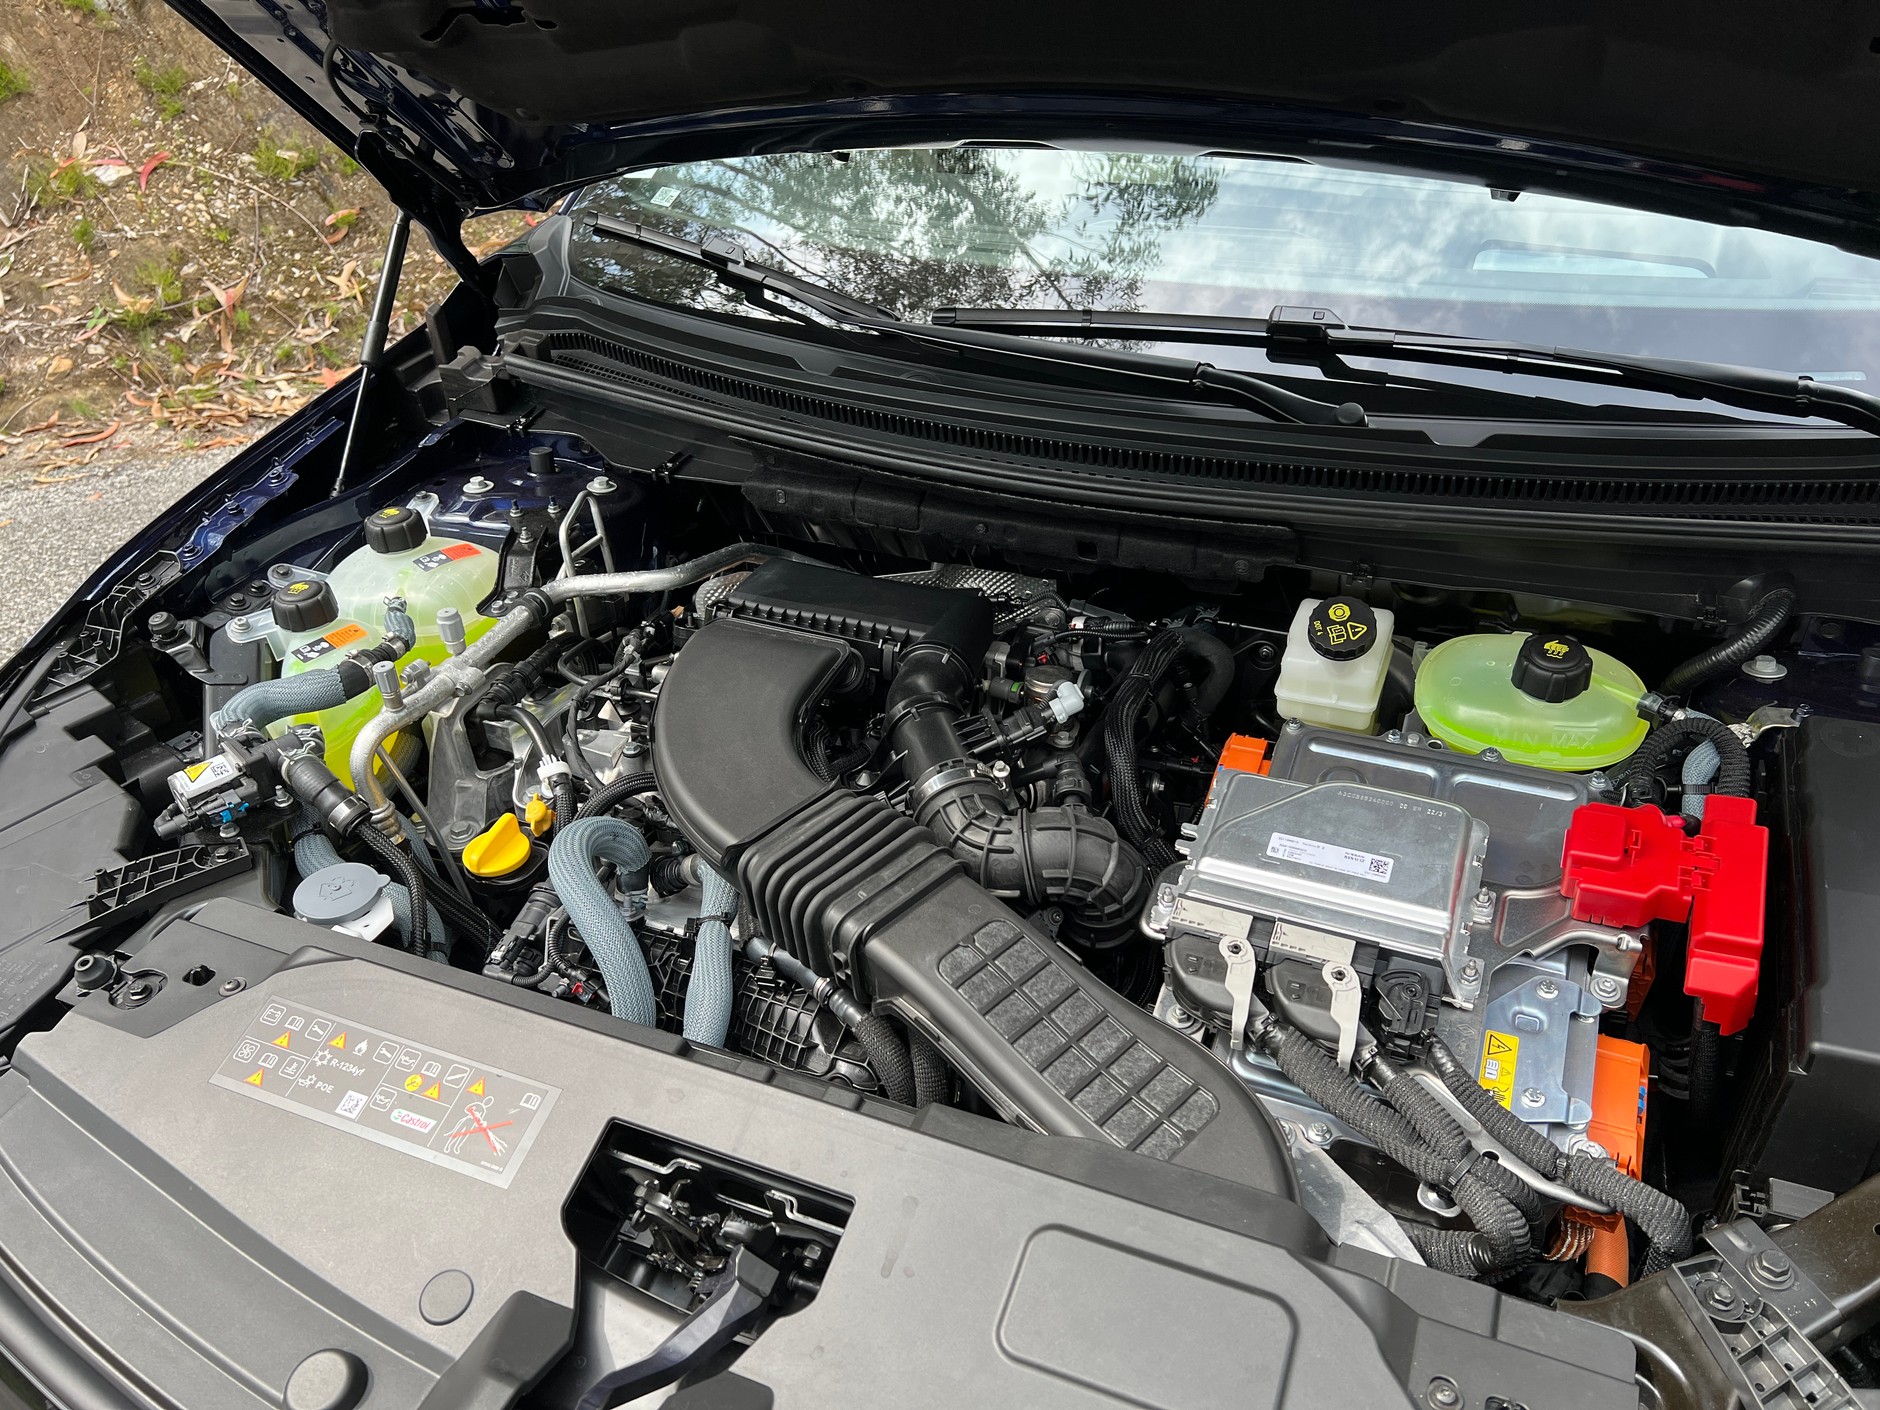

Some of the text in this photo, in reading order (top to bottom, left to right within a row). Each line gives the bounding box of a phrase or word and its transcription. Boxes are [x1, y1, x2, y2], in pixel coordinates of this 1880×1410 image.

[1313, 620, 1323, 631] DOT
[1492, 728, 1596, 750] MIN MAX
[330, 1058, 366, 1076] R-1234yf
[314, 1080, 335, 1094] POE
[400, 1113, 432, 1131] Castrol
